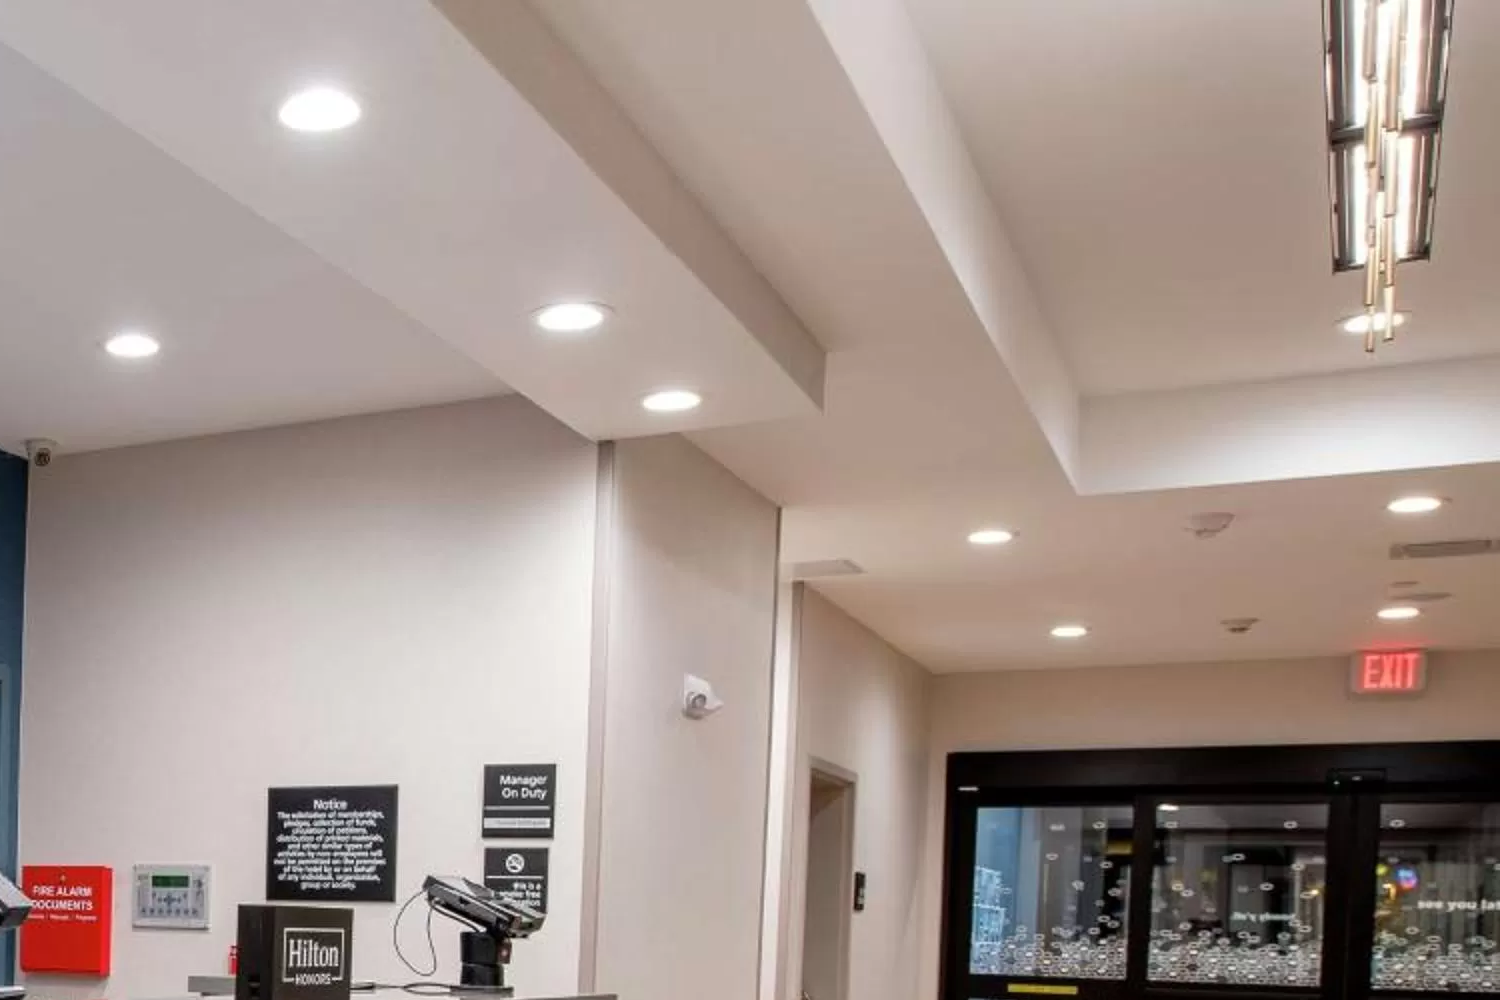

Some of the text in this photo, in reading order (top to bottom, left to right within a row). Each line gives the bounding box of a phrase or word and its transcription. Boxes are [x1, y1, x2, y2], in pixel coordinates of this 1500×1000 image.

[1363, 653, 1419, 689] EXIT
[500, 775, 548, 787] Manager
[502, 787, 547, 800] On Duty
[314, 798, 348, 810] Notice
[32, 885, 93, 897] FIRE ALARM
[30, 899, 93, 911] DOCUMENTS
[1446, 900, 1477, 912] you
[288, 938, 339, 967] Hilton
[295, 973, 332, 985] HONORS
